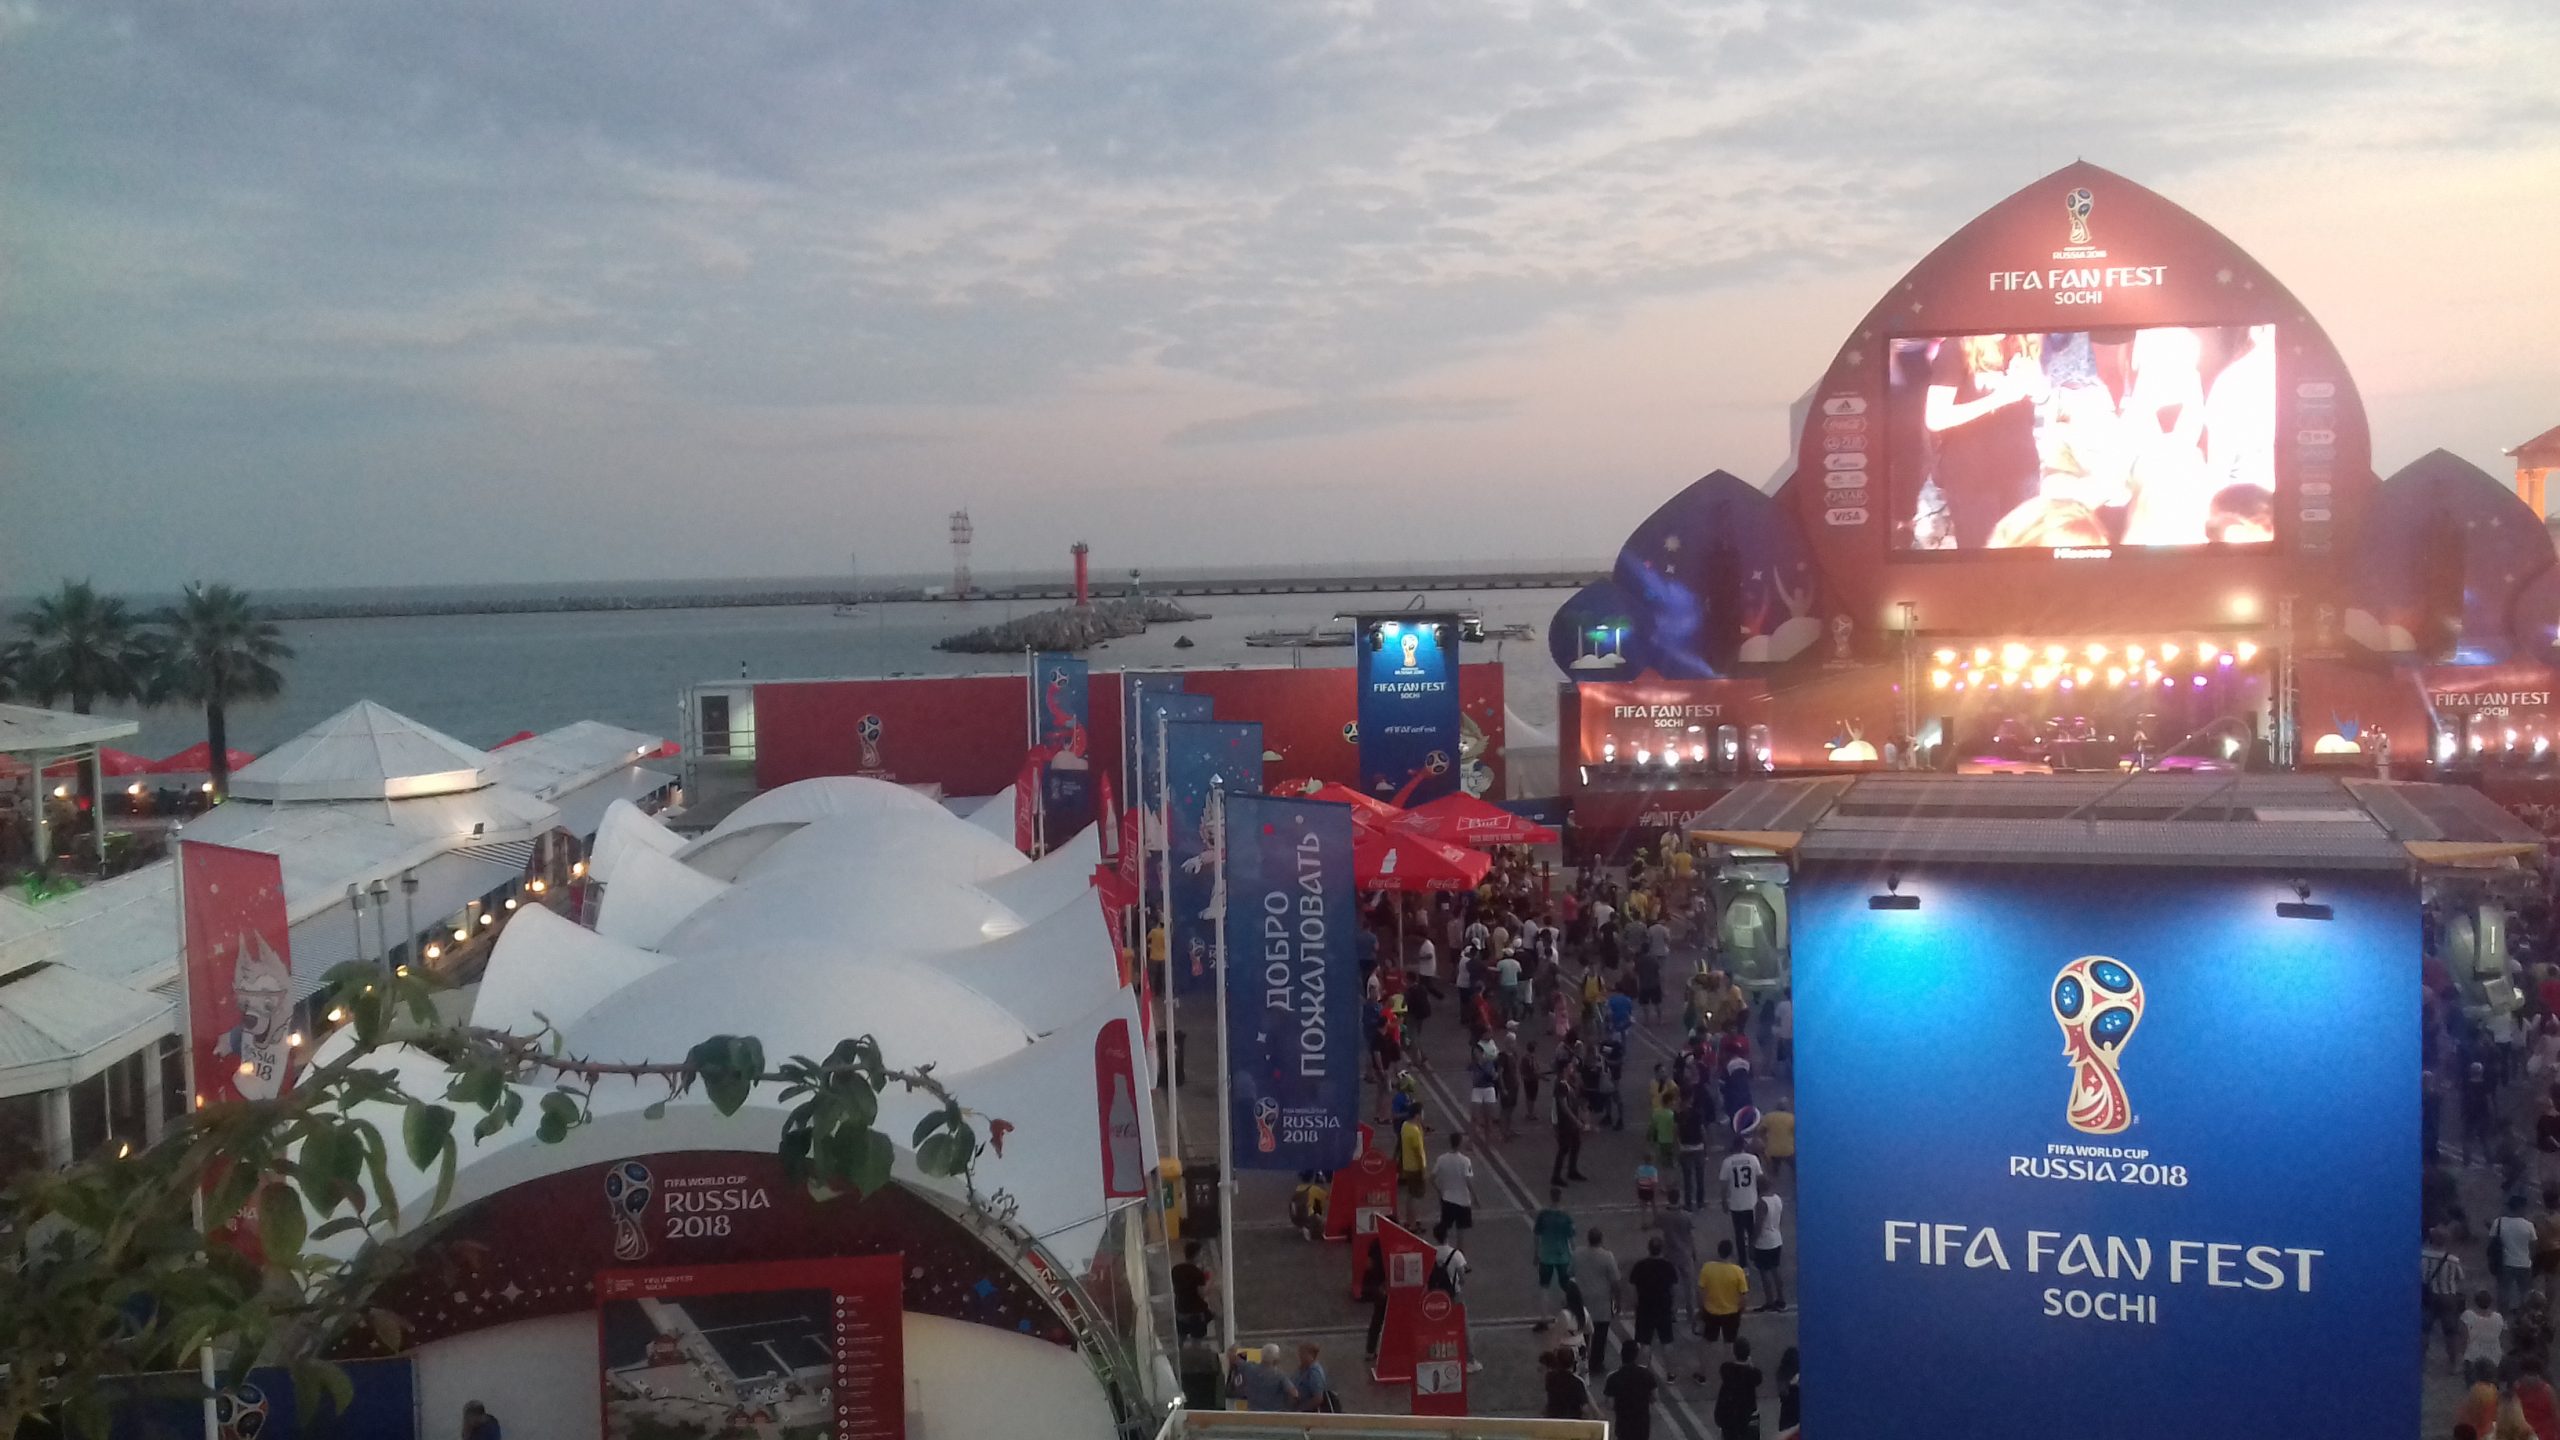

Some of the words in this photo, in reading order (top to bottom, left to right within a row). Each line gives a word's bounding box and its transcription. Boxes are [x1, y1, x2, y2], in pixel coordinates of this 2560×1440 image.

[1989, 270, 2043, 291] FIFA
[2048, 269, 2101, 289] FAN
[2105, 266, 2168, 288] FEST
[2054, 291, 2103, 305] SOCHI
[1832, 511, 1861, 521] VISA
[1373, 683, 1396, 692] FIFA
[1397, 682, 1419, 692] FAN
[1420, 682, 1446, 691] FEST
[2435, 693, 2471, 706] FIFA
[2474, 692, 2509, 706] FAN
[2511, 691, 2551, 705] FEST
[1614, 705, 1648, 718] FIFA
[1650, 705, 1682, 717] FAN
[1685, 704, 1722, 717] FEST
[2478, 706, 2509, 717] SOCHI
[1654, 719, 1684, 728] SOCHI
[1468, 817, 1499, 829] Bud
[1264, 890, 1295, 1012] ДОБРО
[1297, 832, 1326, 1077] ПОЖАЛОВАТЬ
[1282, 1115, 1340, 1128] RUSSIA
[1282, 1129, 1319, 1143] 2018
[2047, 1143, 2075, 1156] FIFA
[2075, 1146, 2122, 1158] WORLD
[2123, 1149, 2149, 1160] CUP
[1732, 1166, 1752, 1189] 13
[2009, 1155, 2118, 1183] RUSSIA
[2120, 1162, 2189, 1187] 2018
[664, 1179, 687, 1188] FIFA
[687, 1177, 725, 1187] WORLD
[726, 1175, 747, 1185] CUP
[664, 1188, 771, 1213] RUSSIA
[666, 1215, 732, 1238] 2018
[1884, 1219, 2011, 1272] FIFA
[2027, 1230, 2152, 1281] FAN
[2169, 1239, 2325, 1292] FEST
[2042, 1287, 2157, 1325] SOCHI
